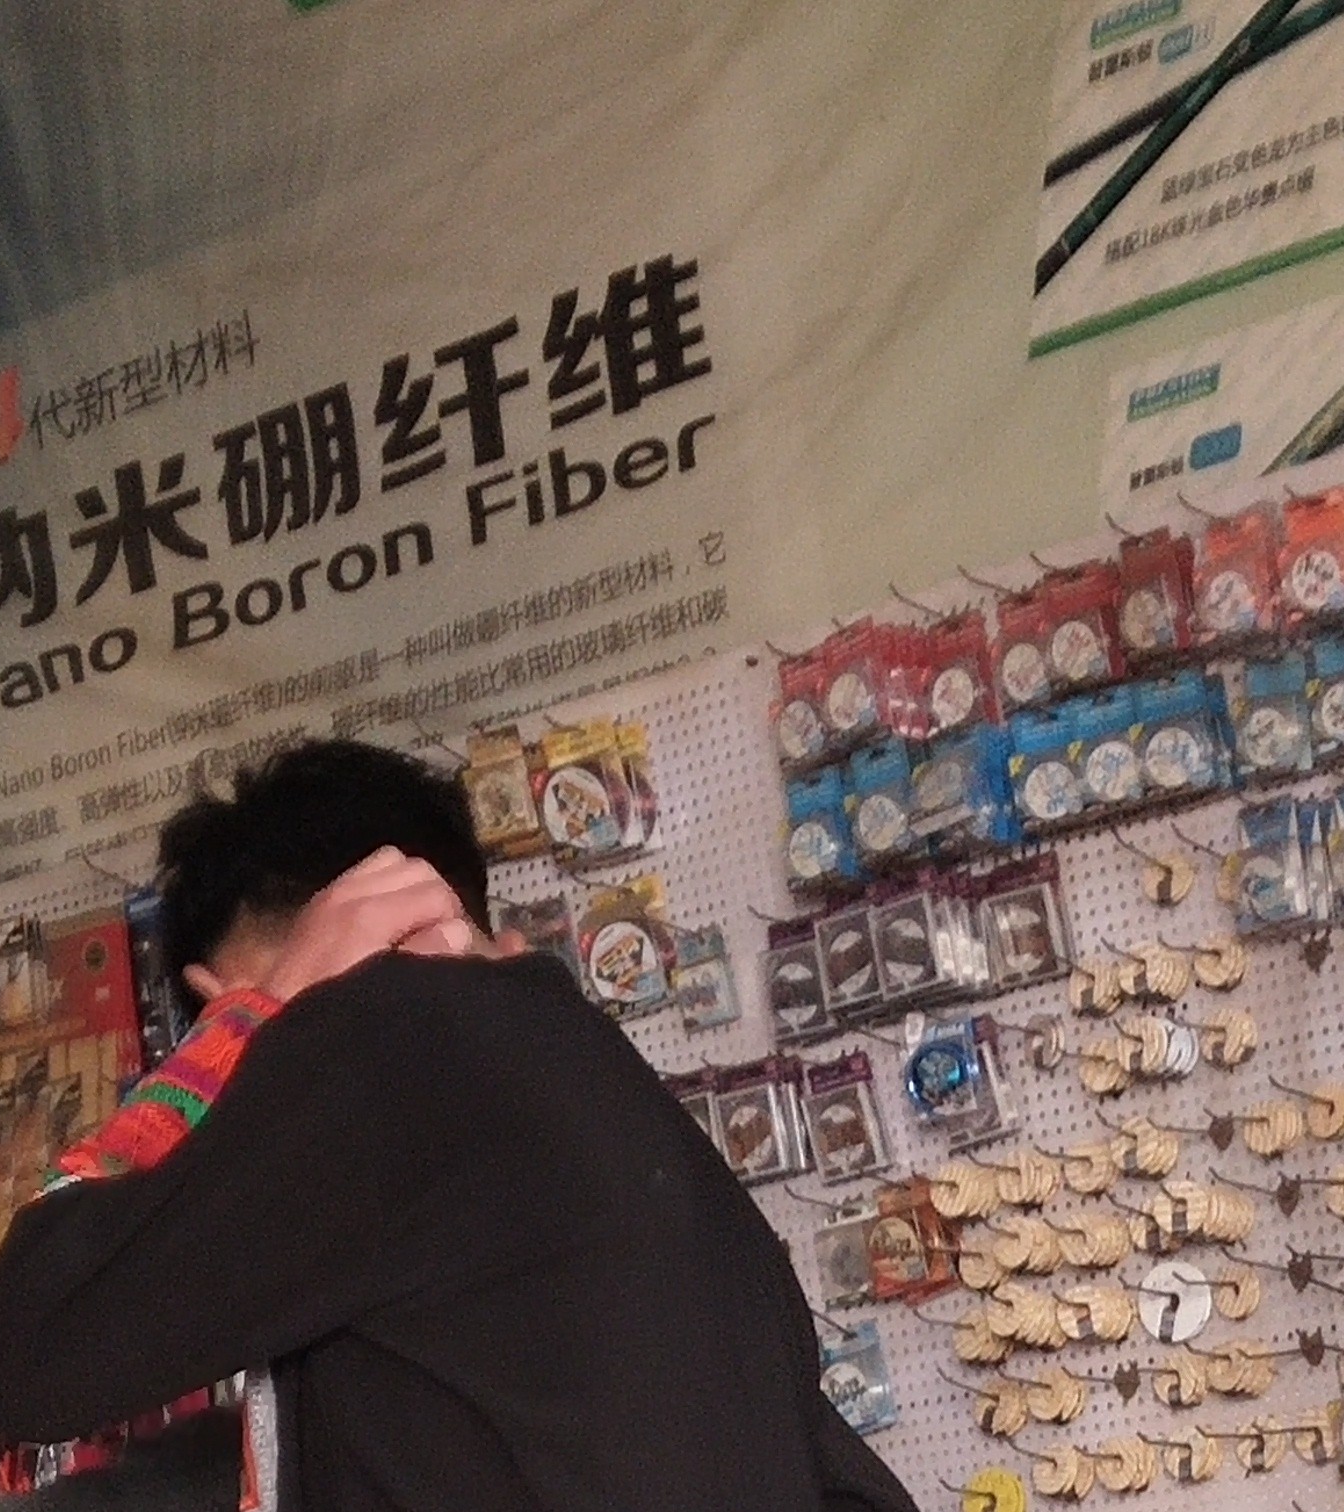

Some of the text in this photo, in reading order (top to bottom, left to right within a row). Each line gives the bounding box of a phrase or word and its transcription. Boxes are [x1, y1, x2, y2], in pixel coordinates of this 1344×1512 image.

[170, 520, 435, 652] Boron
[467, 415, 717, 548] Fiber
[50, 746, 113, 783] Boron
